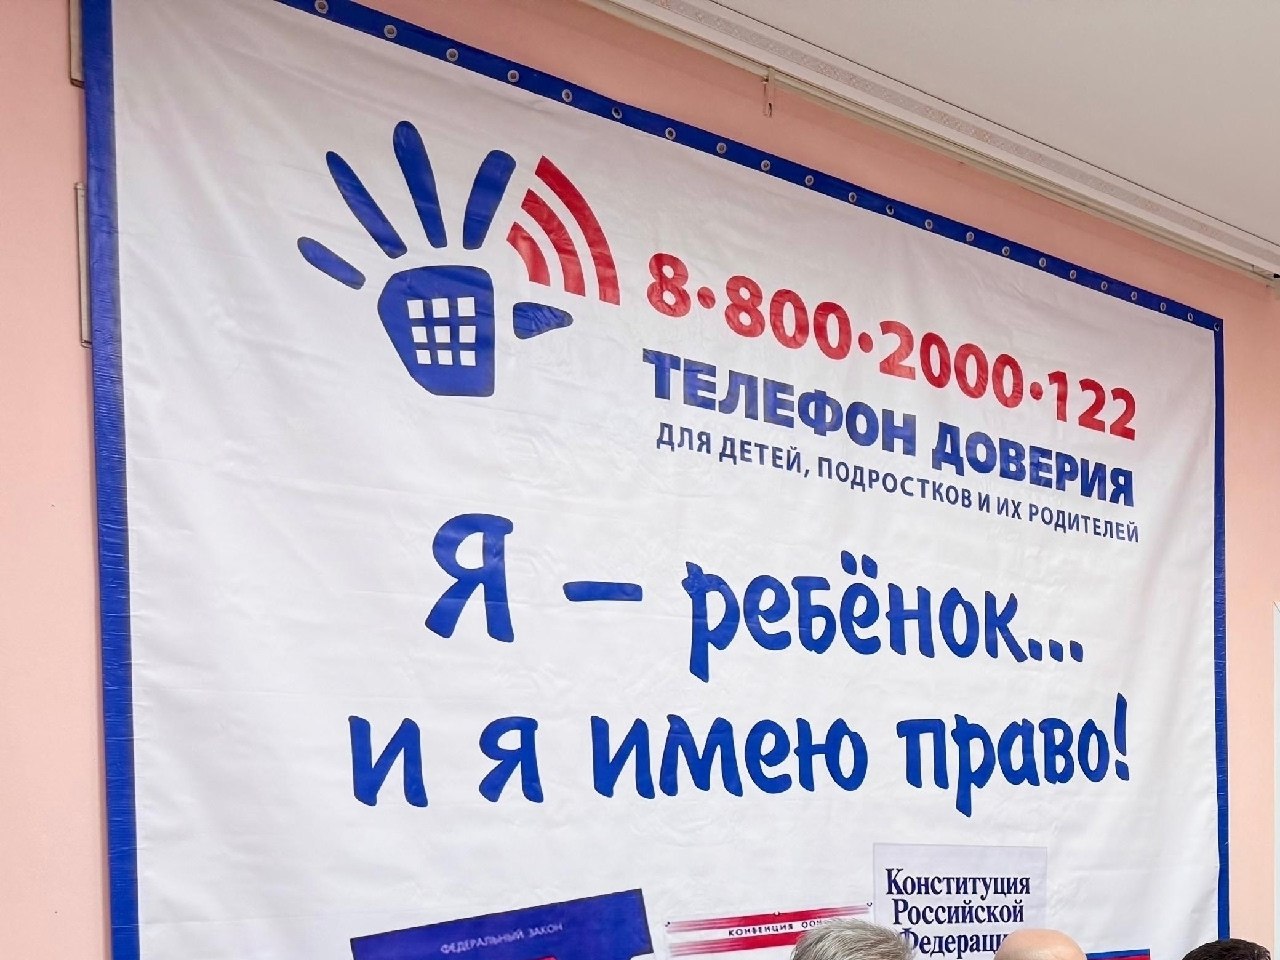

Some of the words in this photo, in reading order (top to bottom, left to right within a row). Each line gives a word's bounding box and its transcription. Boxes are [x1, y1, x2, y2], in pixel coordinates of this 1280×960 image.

[643, 348, 916, 456] ТЕЛЕФОН
[932, 422, 1134, 507] ДОВЕРИЯ
[656, 422, 711, 455] ДЛЯ
[718, 435, 810, 477] ДЕТЕЙ,
[817, 456, 972, 509] ПОДРОСТКОВ
[977, 491, 991, 514] И
[996, 496, 1023, 520] ИХ
[1028, 503, 1139, 543] РОДИТЕЛЕЙ
[426, 513, 515, 643] Я
[682, 551, 1084, 682] ребёнок...
[349, 715, 429, 807] и
[479, 716, 544, 804] я
[591, 715, 868, 800] имею
[895, 695, 1130, 817] право!
[885, 868, 1031, 901] Конституция
[892, 898, 1024, 925] Российской
[440, 929, 525, 954] ФЕДЕРАЛЬНЫЙ
[529, 923, 562, 938] ЗАКОН
[728, 923, 794, 936] КОНВЕНЦИЯ
[899, 927, 1010, 960] Федерац
